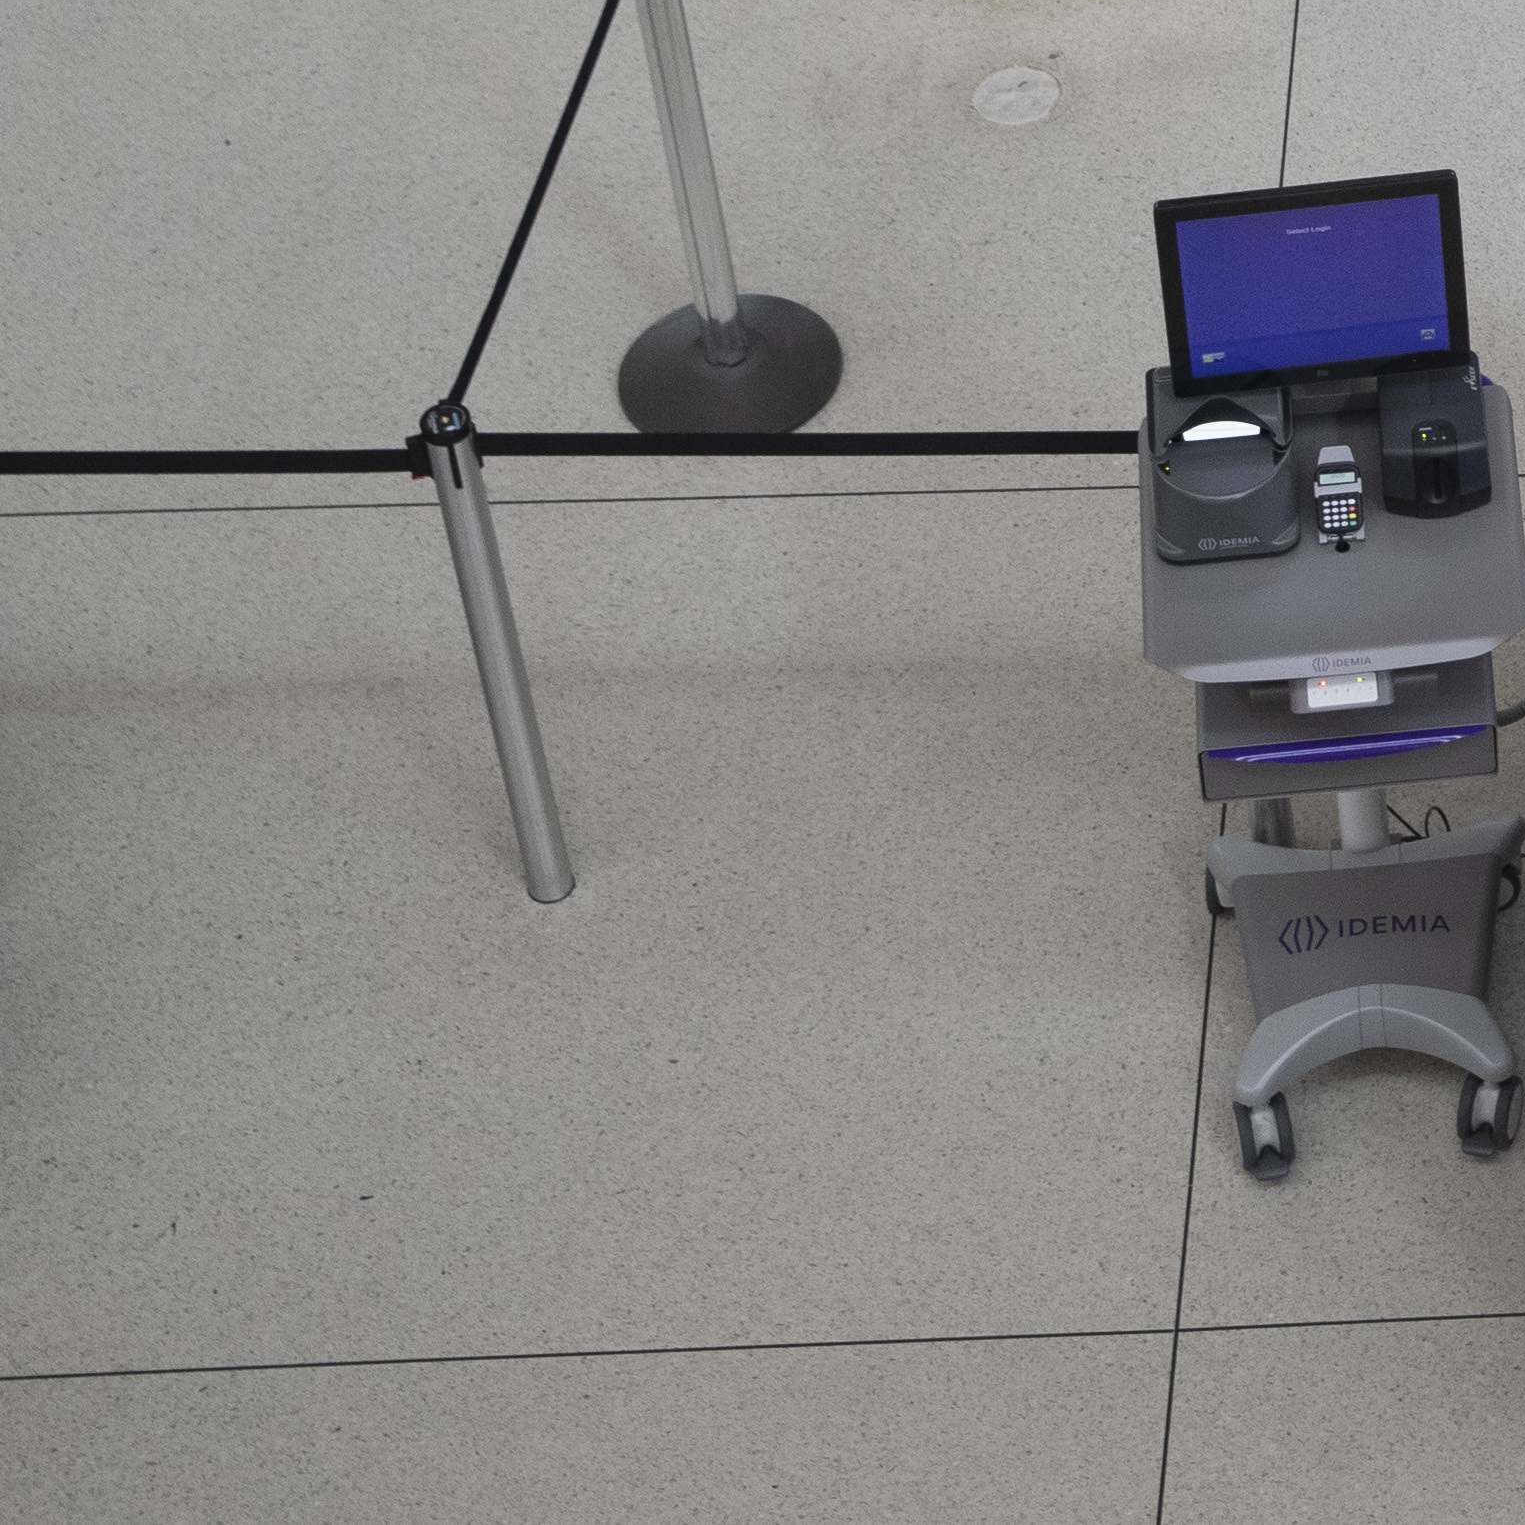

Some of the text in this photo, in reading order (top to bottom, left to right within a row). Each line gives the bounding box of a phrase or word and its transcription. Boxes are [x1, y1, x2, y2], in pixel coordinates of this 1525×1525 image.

[1219, 536, 1260, 546] IDEMIA
[1332, 656, 1372, 667] IDEMIA
[1338, 914, 1451, 938] IDEMIA
